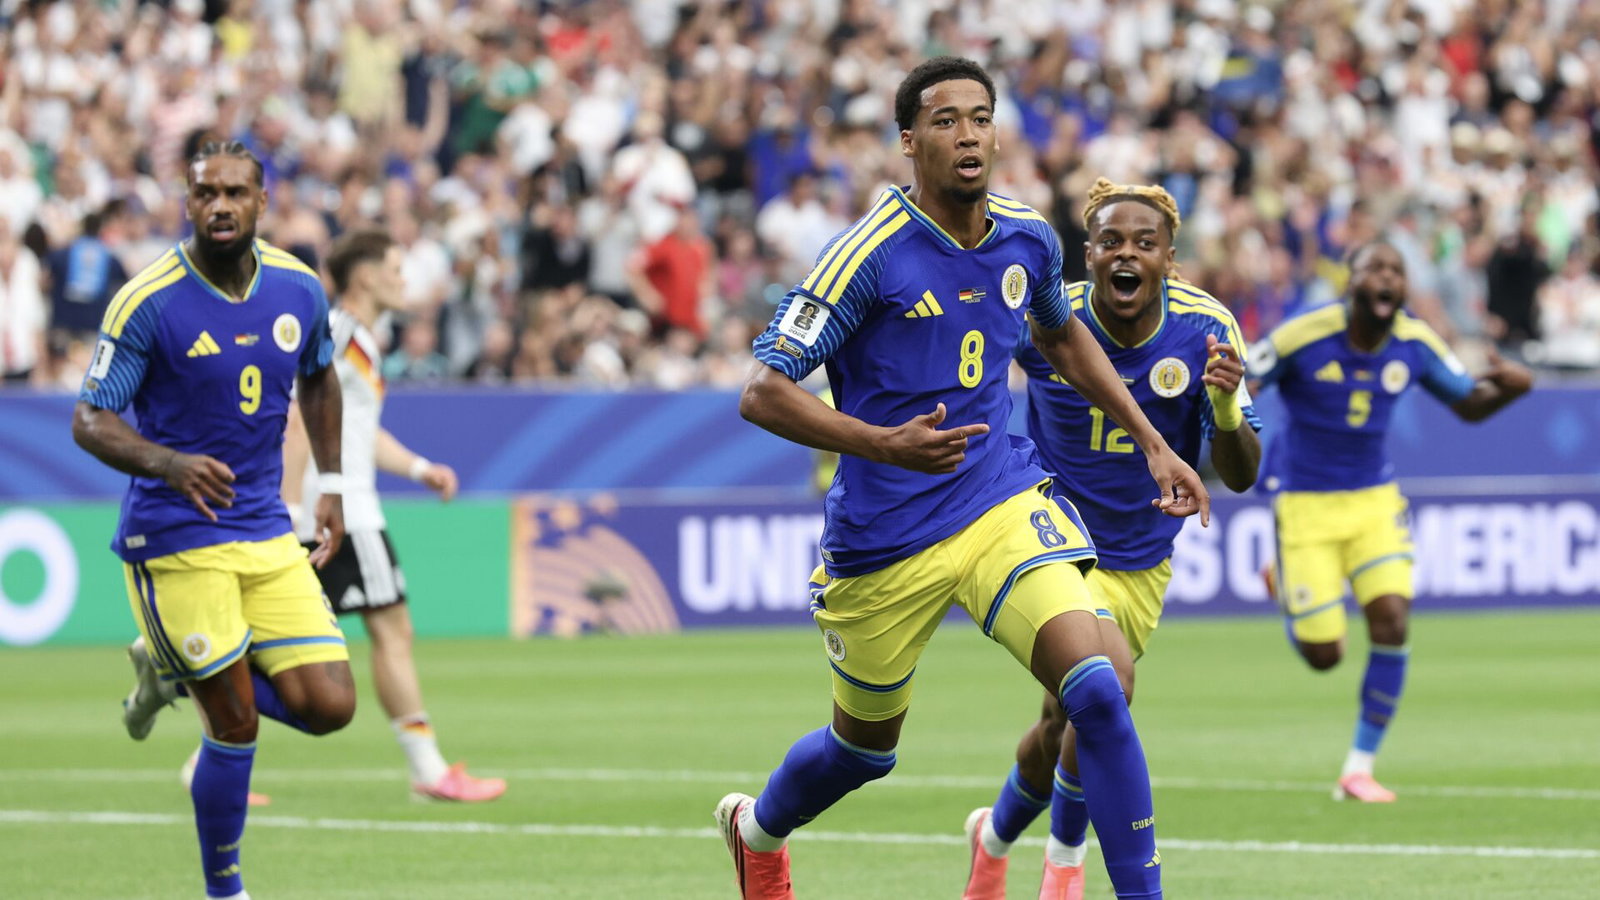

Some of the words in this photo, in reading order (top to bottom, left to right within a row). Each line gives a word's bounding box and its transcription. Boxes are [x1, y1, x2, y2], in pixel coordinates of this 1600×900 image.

[788, 328, 806, 340] 2026
[958, 330, 985, 389] 8
[239, 364, 262, 415] 9
[1346, 389, 1373, 429] 5
[1089, 406, 1134, 453] 12
[1030, 509, 1067, 549] 8
[1411, 502, 1600, 597] MERIC
